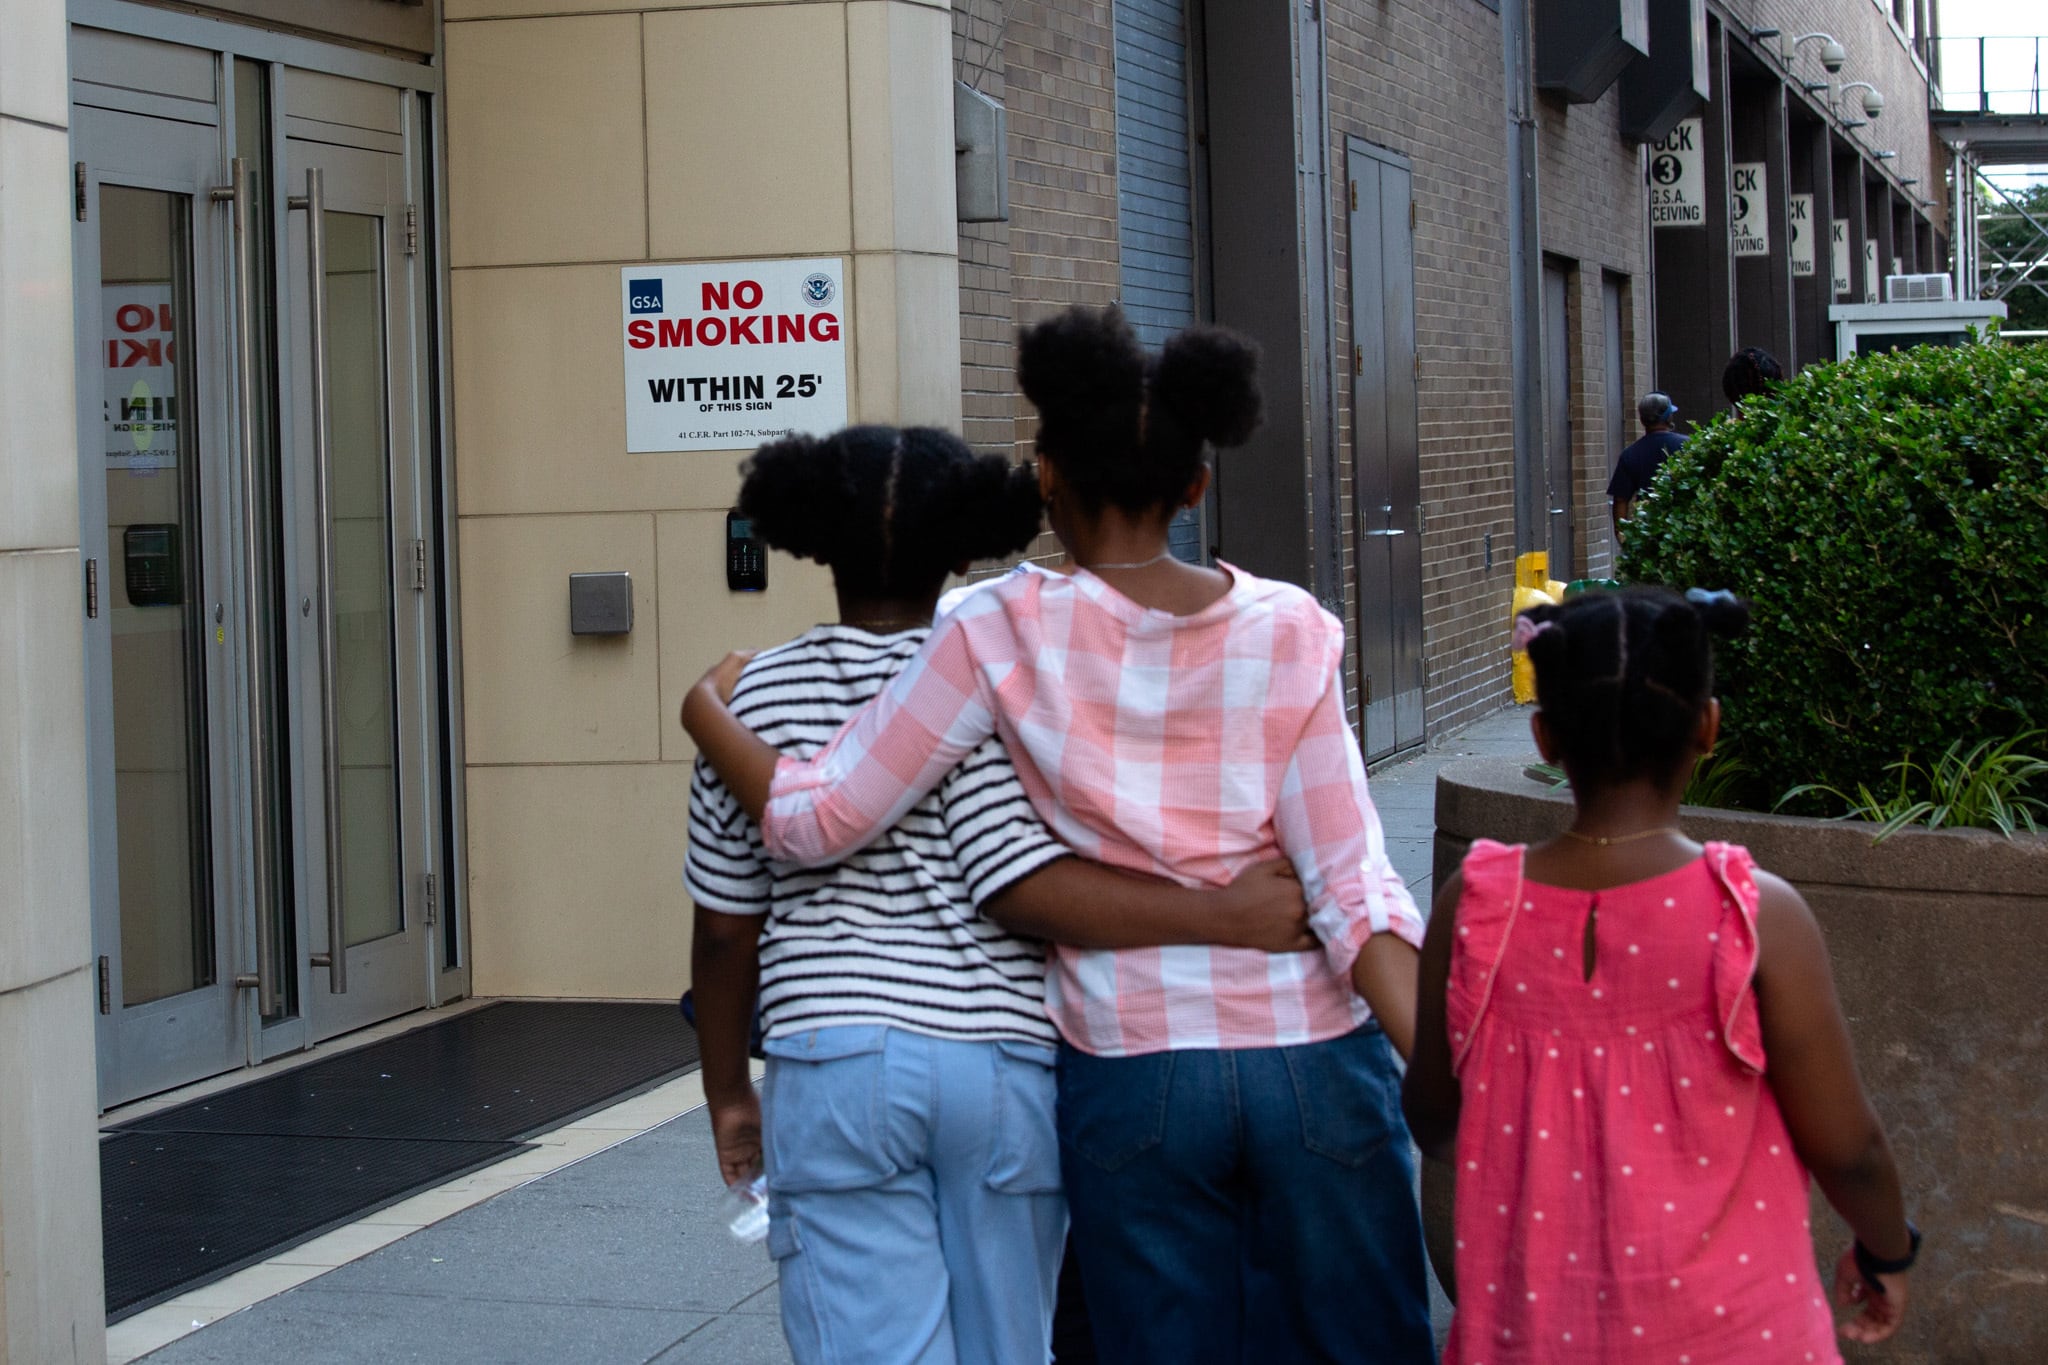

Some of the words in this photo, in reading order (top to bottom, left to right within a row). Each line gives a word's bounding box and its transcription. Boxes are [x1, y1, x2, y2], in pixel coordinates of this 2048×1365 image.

[1734, 169, 1757, 191] CK
[1652, 205, 1700, 221] CEIVING
[1735, 238, 1764, 252] IVING
[632, 296, 662, 309] GSA
[701, 280, 764, 311] NO
[627, 312, 840, 349] SMOKING
[648, 375, 764, 403] WITHIN
[776, 373, 822, 398] 25'
[699, 404, 714, 412] OF
[716, 402, 742, 412] THIS
[745, 401, 772, 411] SIGN
[678, 431, 687, 439] 41
[688, 431, 711, 439] C.F.R.
[713, 430, 729, 438] Part
[730, 429, 756, 438] 102-74,
[757, 428, 787, 438] Subpart
